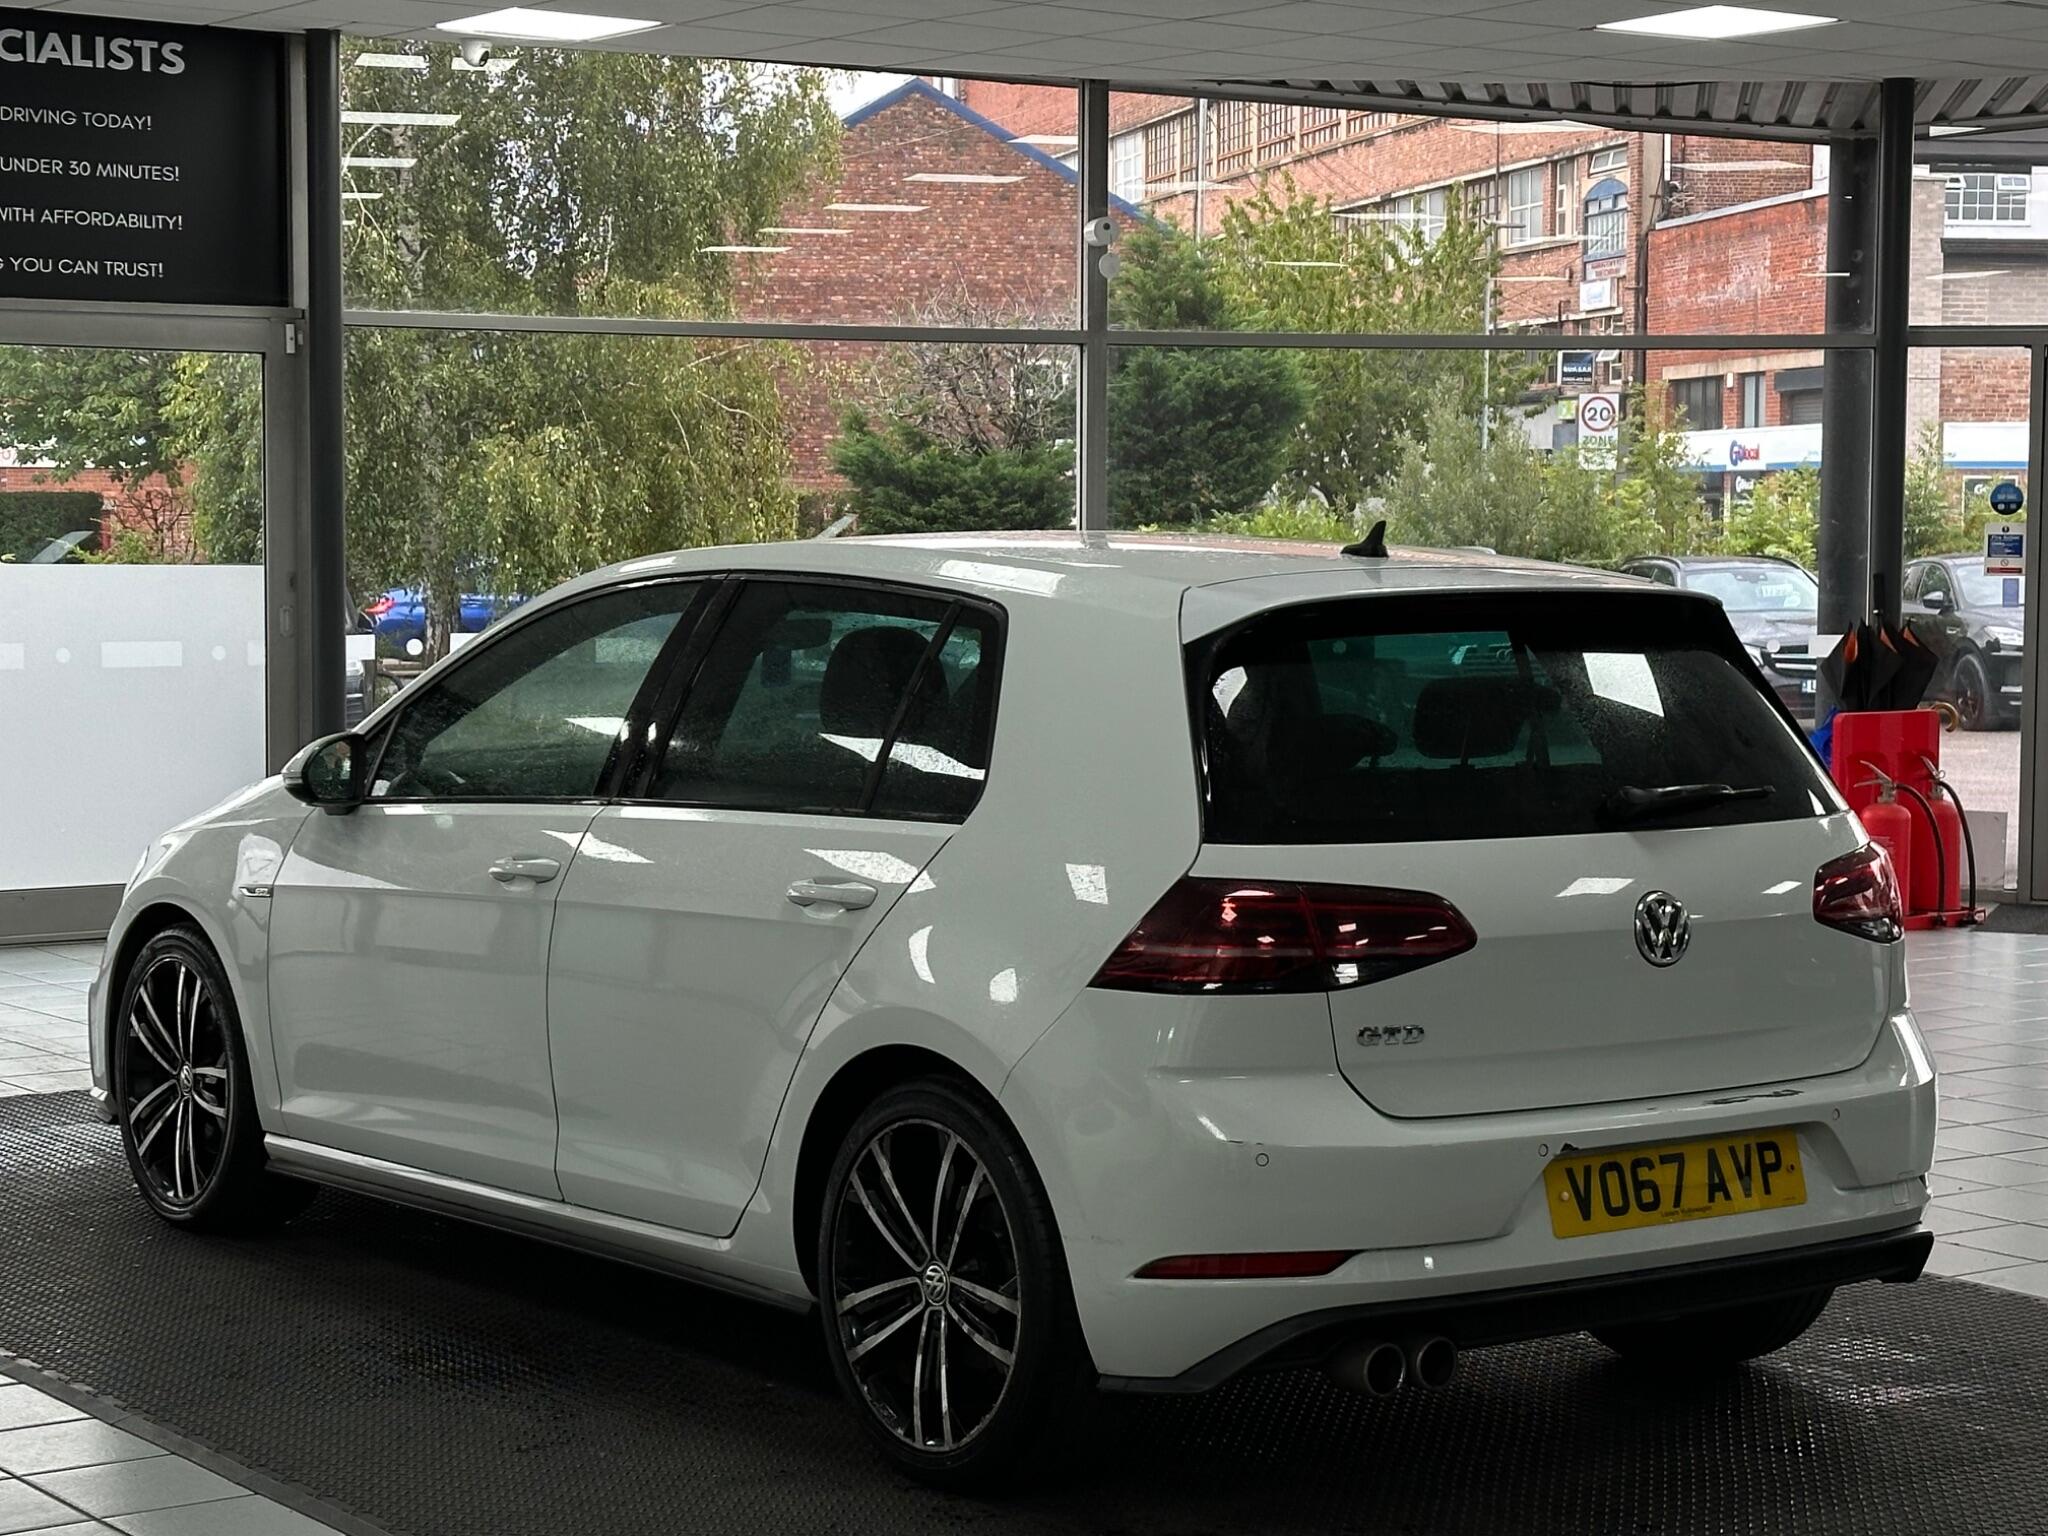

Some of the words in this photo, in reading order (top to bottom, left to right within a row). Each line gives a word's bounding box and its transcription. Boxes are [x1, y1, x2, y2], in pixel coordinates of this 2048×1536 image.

[0, 29, 185, 74] CIALISTS
[1, 106, 76, 125] DRIVING
[83, 112, 151, 130] TODAY!
[0, 157, 62, 174] UNDER
[69, 161, 90, 176] 30
[96, 163, 179, 181] MINUTES!
[41, 210, 182, 230] AFFORDABILITY!
[10, 257, 52, 272] YOU
[59, 260, 98, 274] CAN
[104, 261, 163, 277] TRUST!
[1587, 407, 1611, 421] 20
[1357, 1024, 1424, 1047] GTD
[1707, 1140, 1782, 1204] AVP
